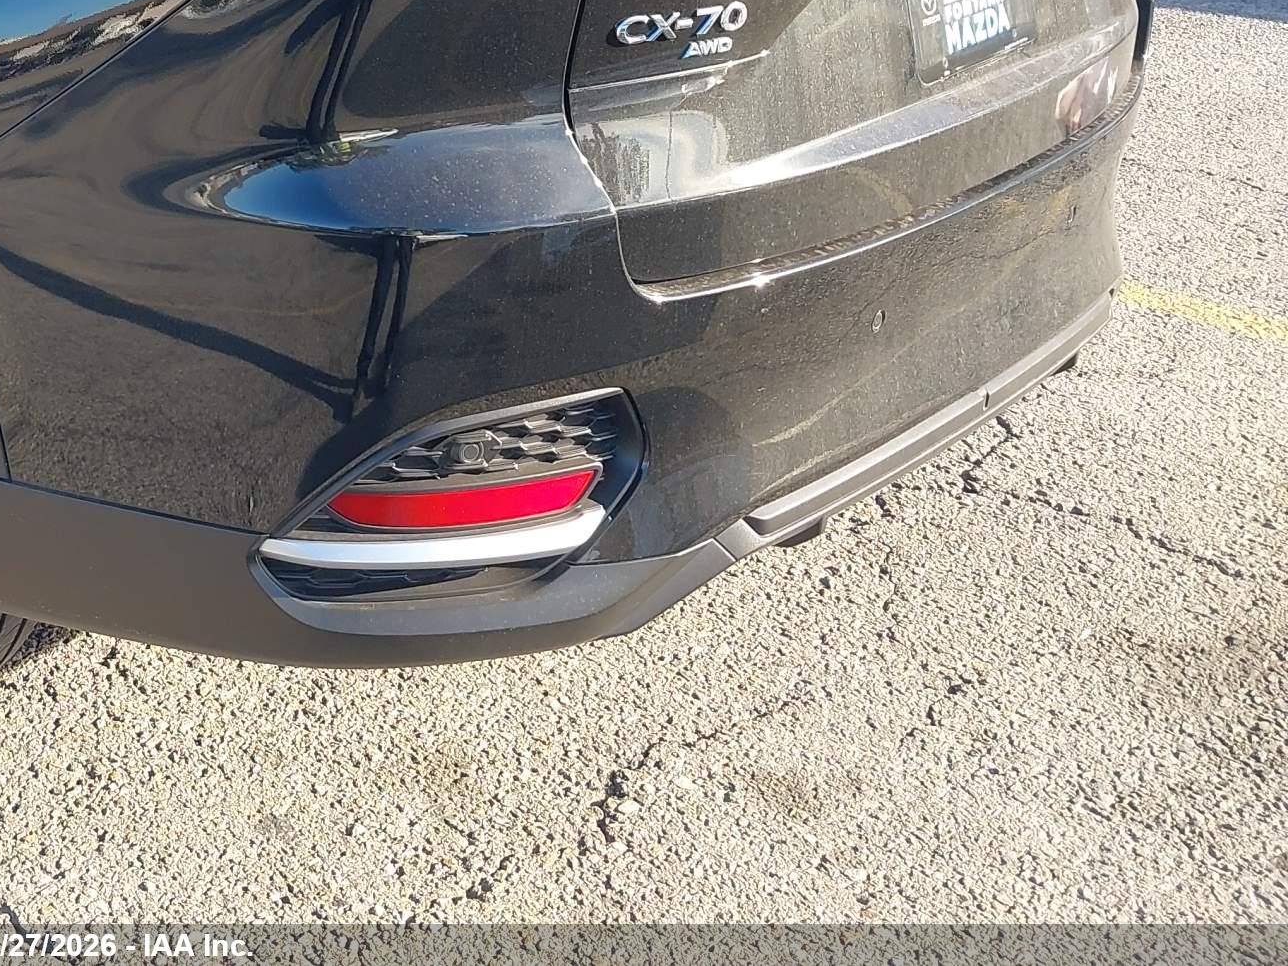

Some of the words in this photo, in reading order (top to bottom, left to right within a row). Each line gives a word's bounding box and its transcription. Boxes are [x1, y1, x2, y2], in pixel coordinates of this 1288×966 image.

[614, 0, 749, 45] CX-70
[944, 4, 1011, 55] MAZDA
[680, 36, 734, 59] AWD
